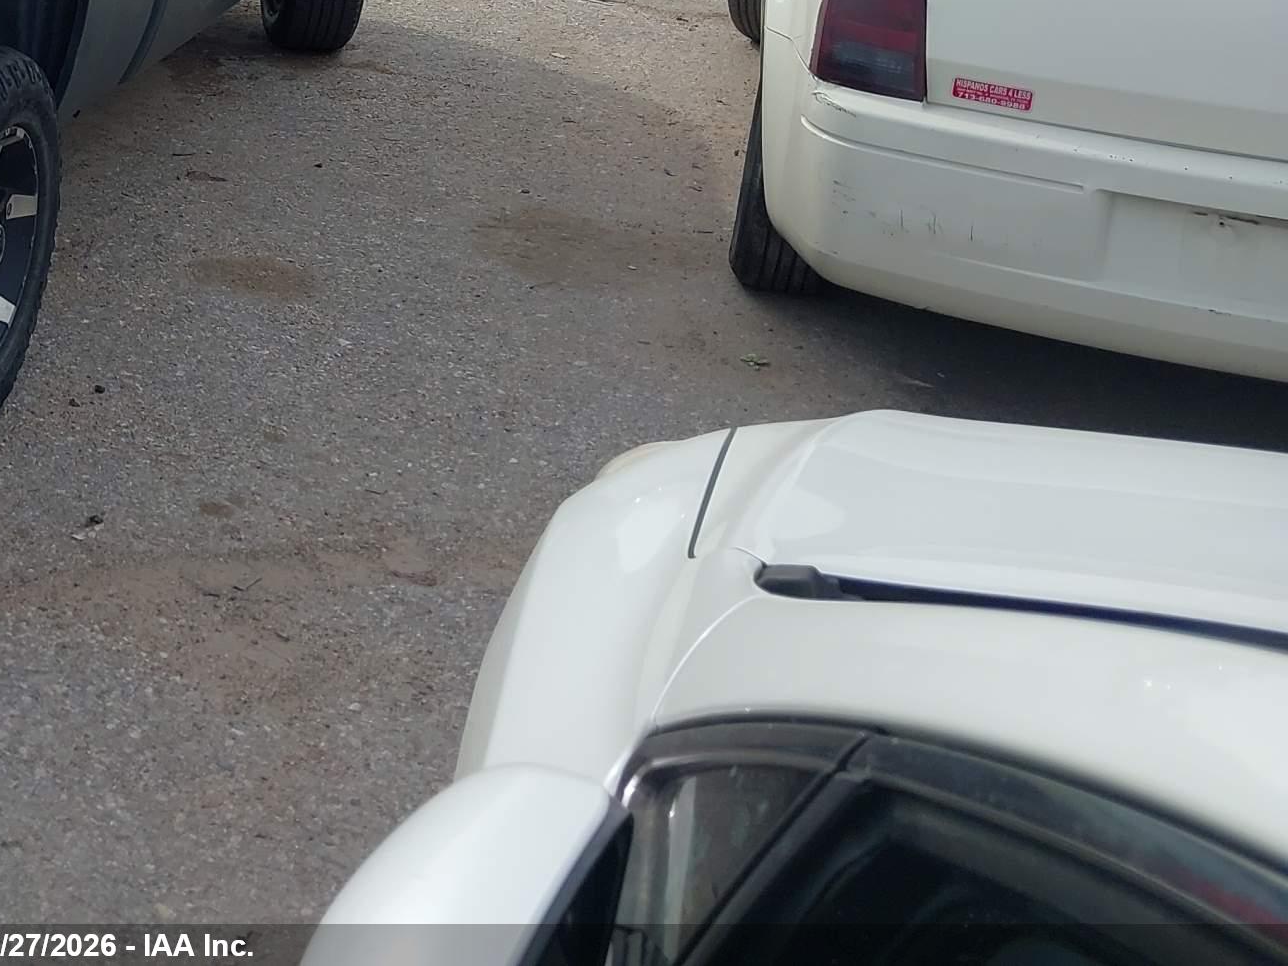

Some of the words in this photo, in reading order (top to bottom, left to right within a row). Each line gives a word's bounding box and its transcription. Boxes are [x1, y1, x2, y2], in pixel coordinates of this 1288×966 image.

[955, 78, 989, 92] HISPANOS
[989, 85, 1008, 96] CARS
[1014, 89, 1031, 100] LESS
